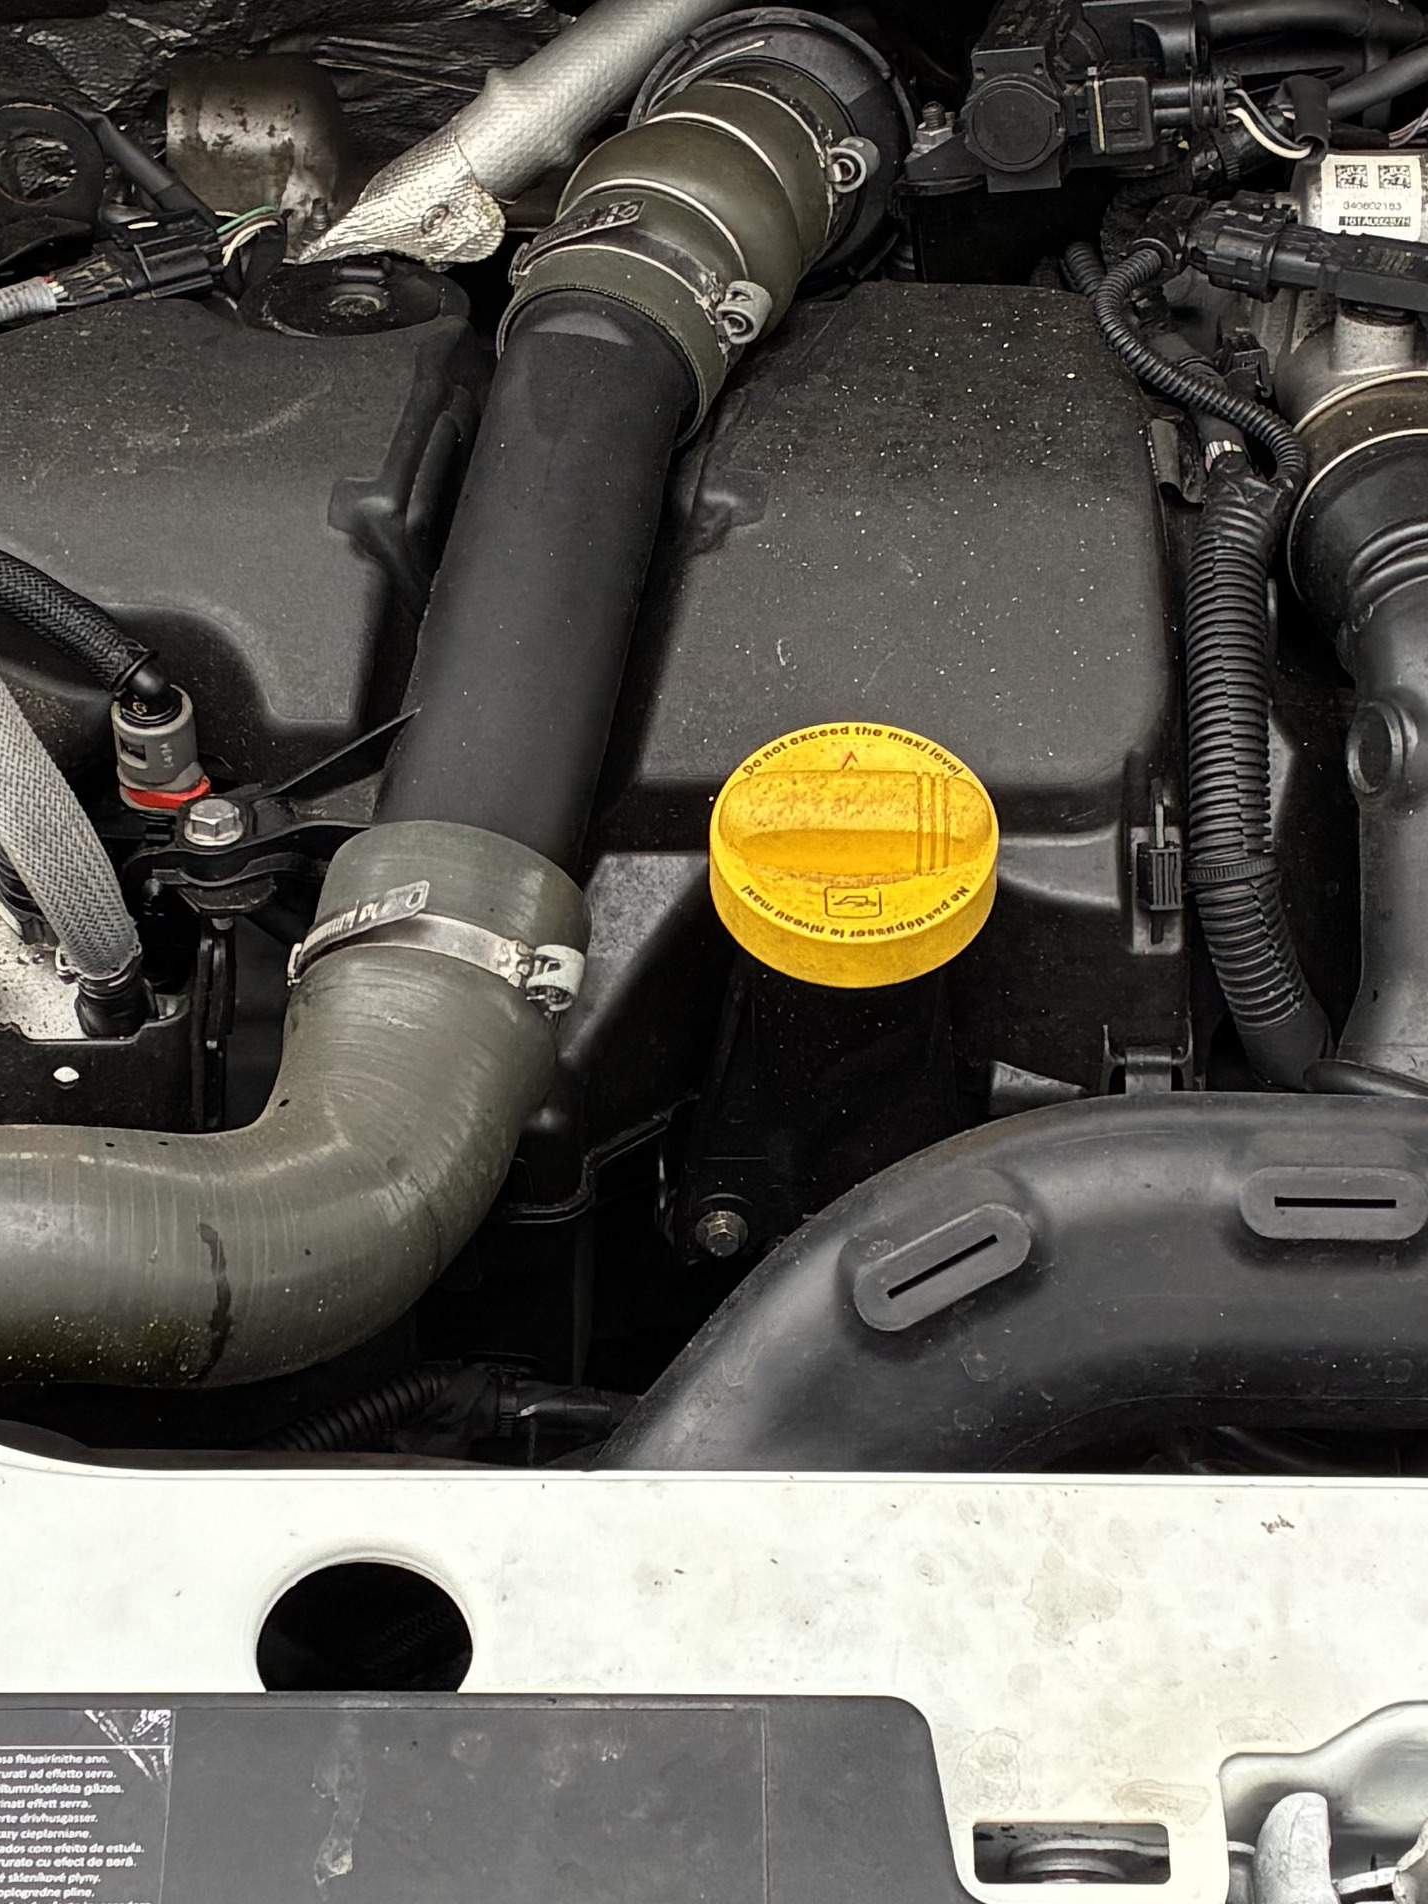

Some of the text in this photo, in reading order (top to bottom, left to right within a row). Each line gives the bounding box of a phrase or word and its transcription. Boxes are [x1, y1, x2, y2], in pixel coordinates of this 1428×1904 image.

[764, 742, 788, 761] not
[789, 725, 850, 746] exceed
[855, 726, 883, 737] the
[929, 747, 963, 776] level
